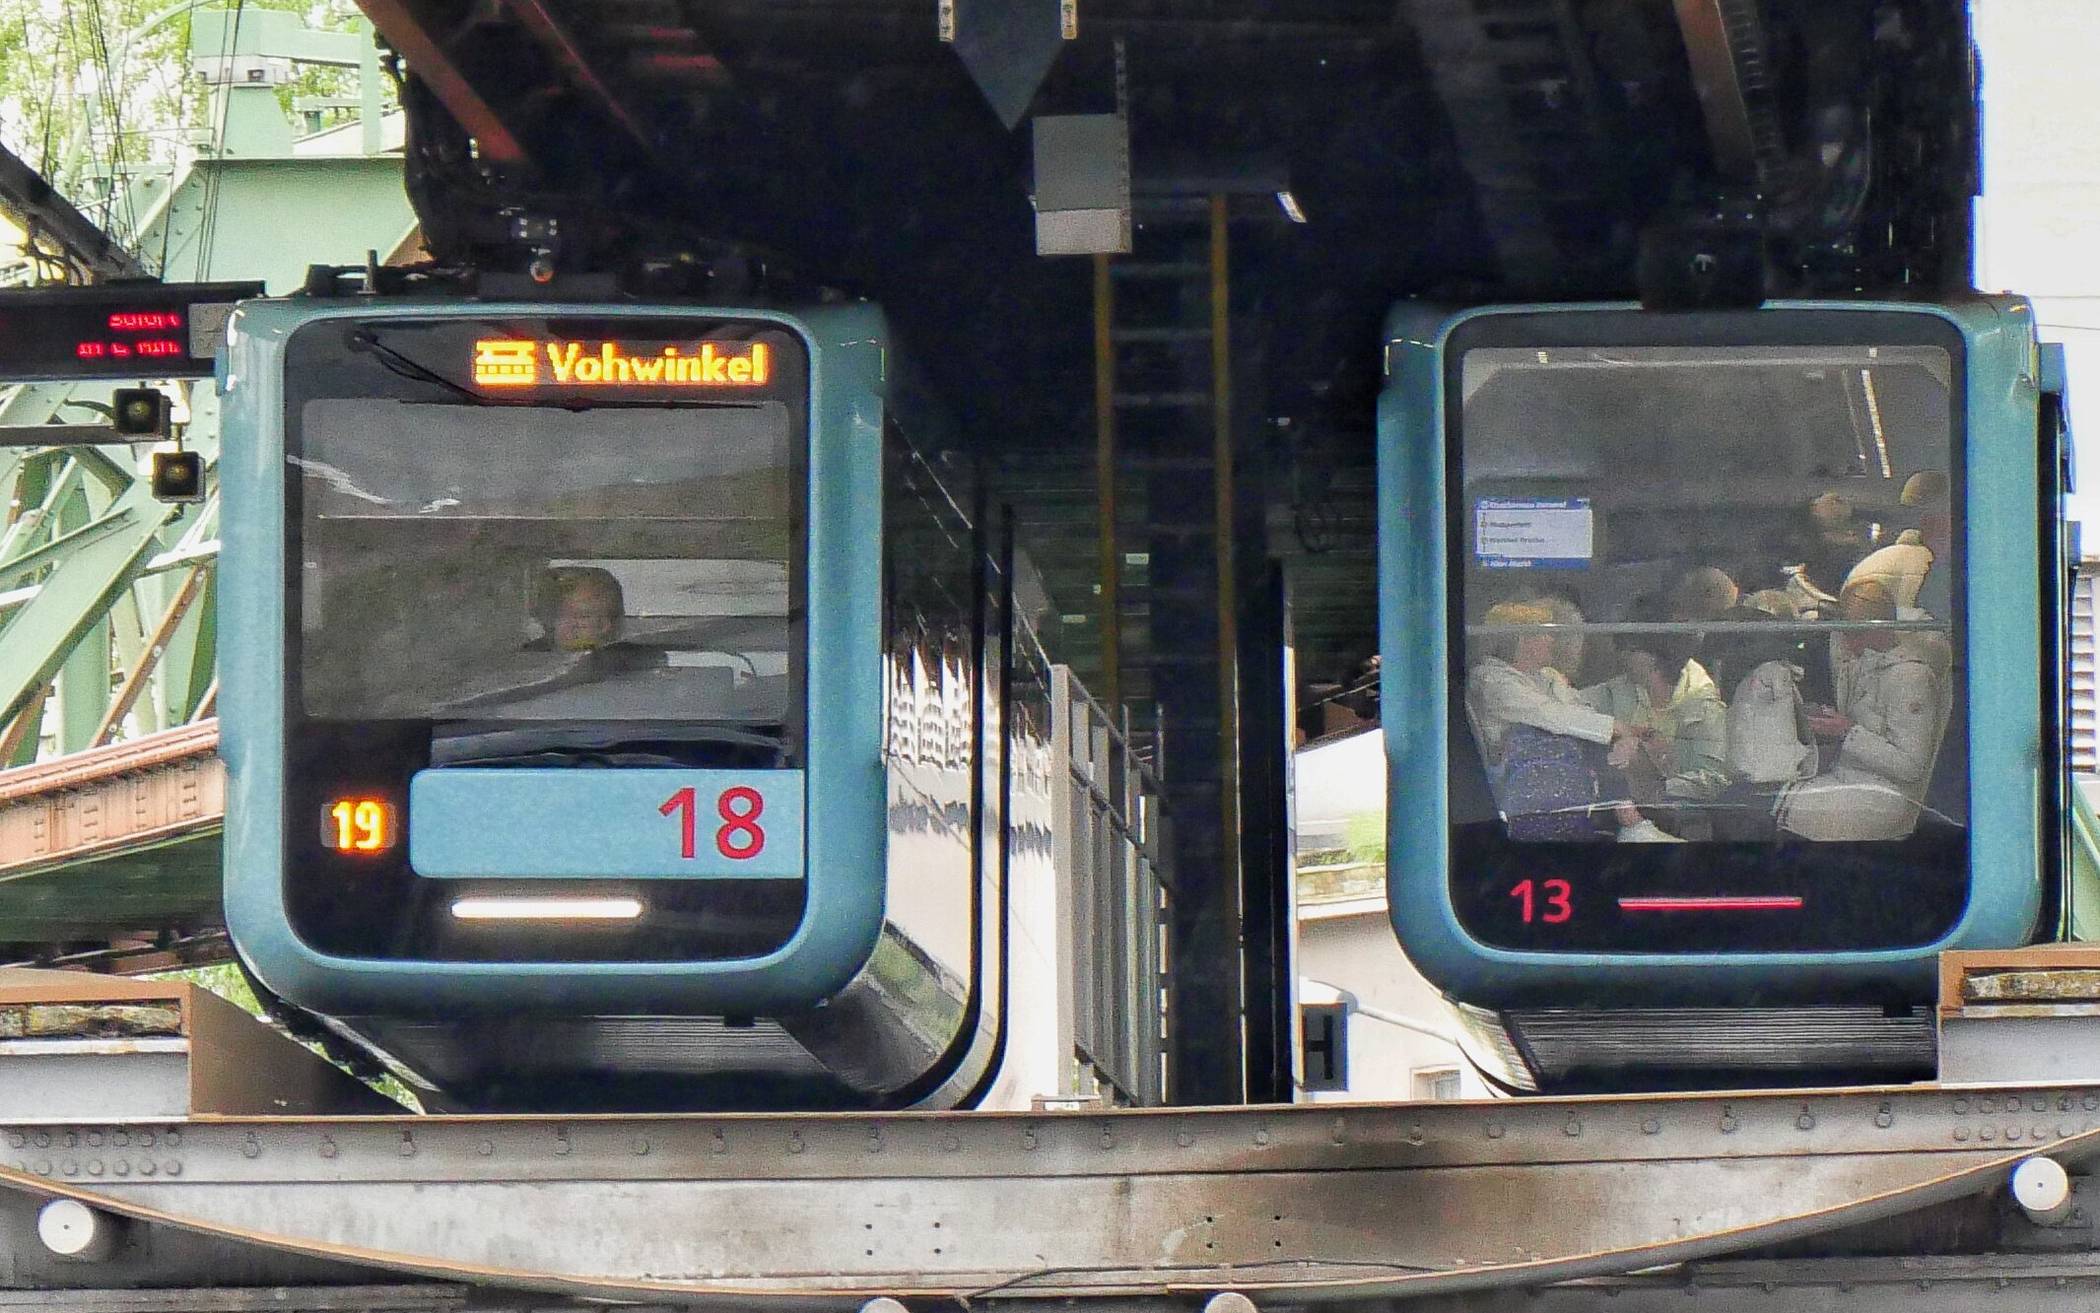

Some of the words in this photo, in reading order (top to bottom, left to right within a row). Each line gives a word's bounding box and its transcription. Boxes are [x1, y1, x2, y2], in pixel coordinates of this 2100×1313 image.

[547, 342, 768, 382] Vohwinkel
[332, 801, 381, 849] 19
[658, 786, 766, 860] 18
[1509, 879, 1573, 924] 13
